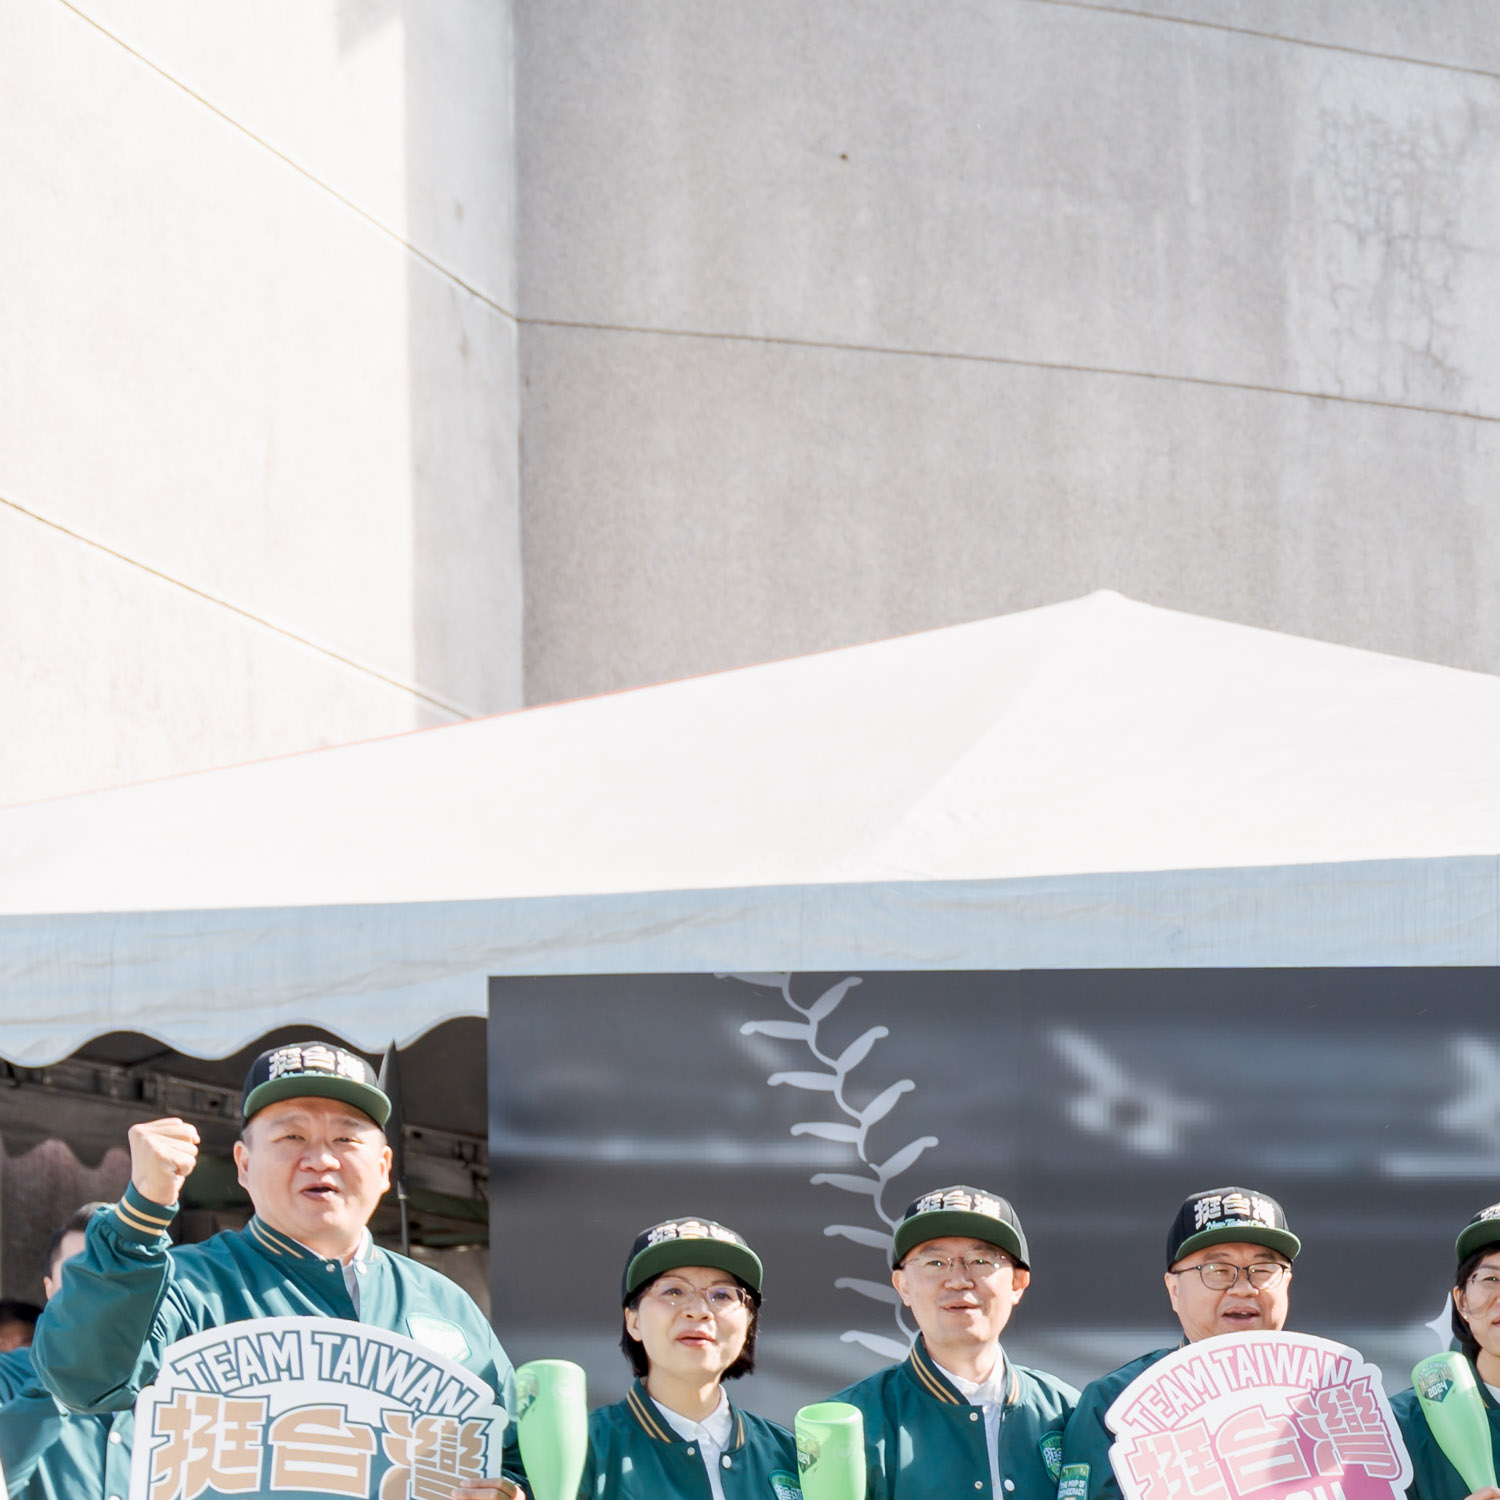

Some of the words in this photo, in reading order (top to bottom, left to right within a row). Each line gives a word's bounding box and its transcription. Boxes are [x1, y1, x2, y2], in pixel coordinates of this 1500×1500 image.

[170, 1330, 302, 1396] TEAM
[310, 1330, 481, 1429] TAIWAN
[1124, 1351, 1213, 1432] TEAM
[1213, 1342, 1352, 1392] TAIWAN
